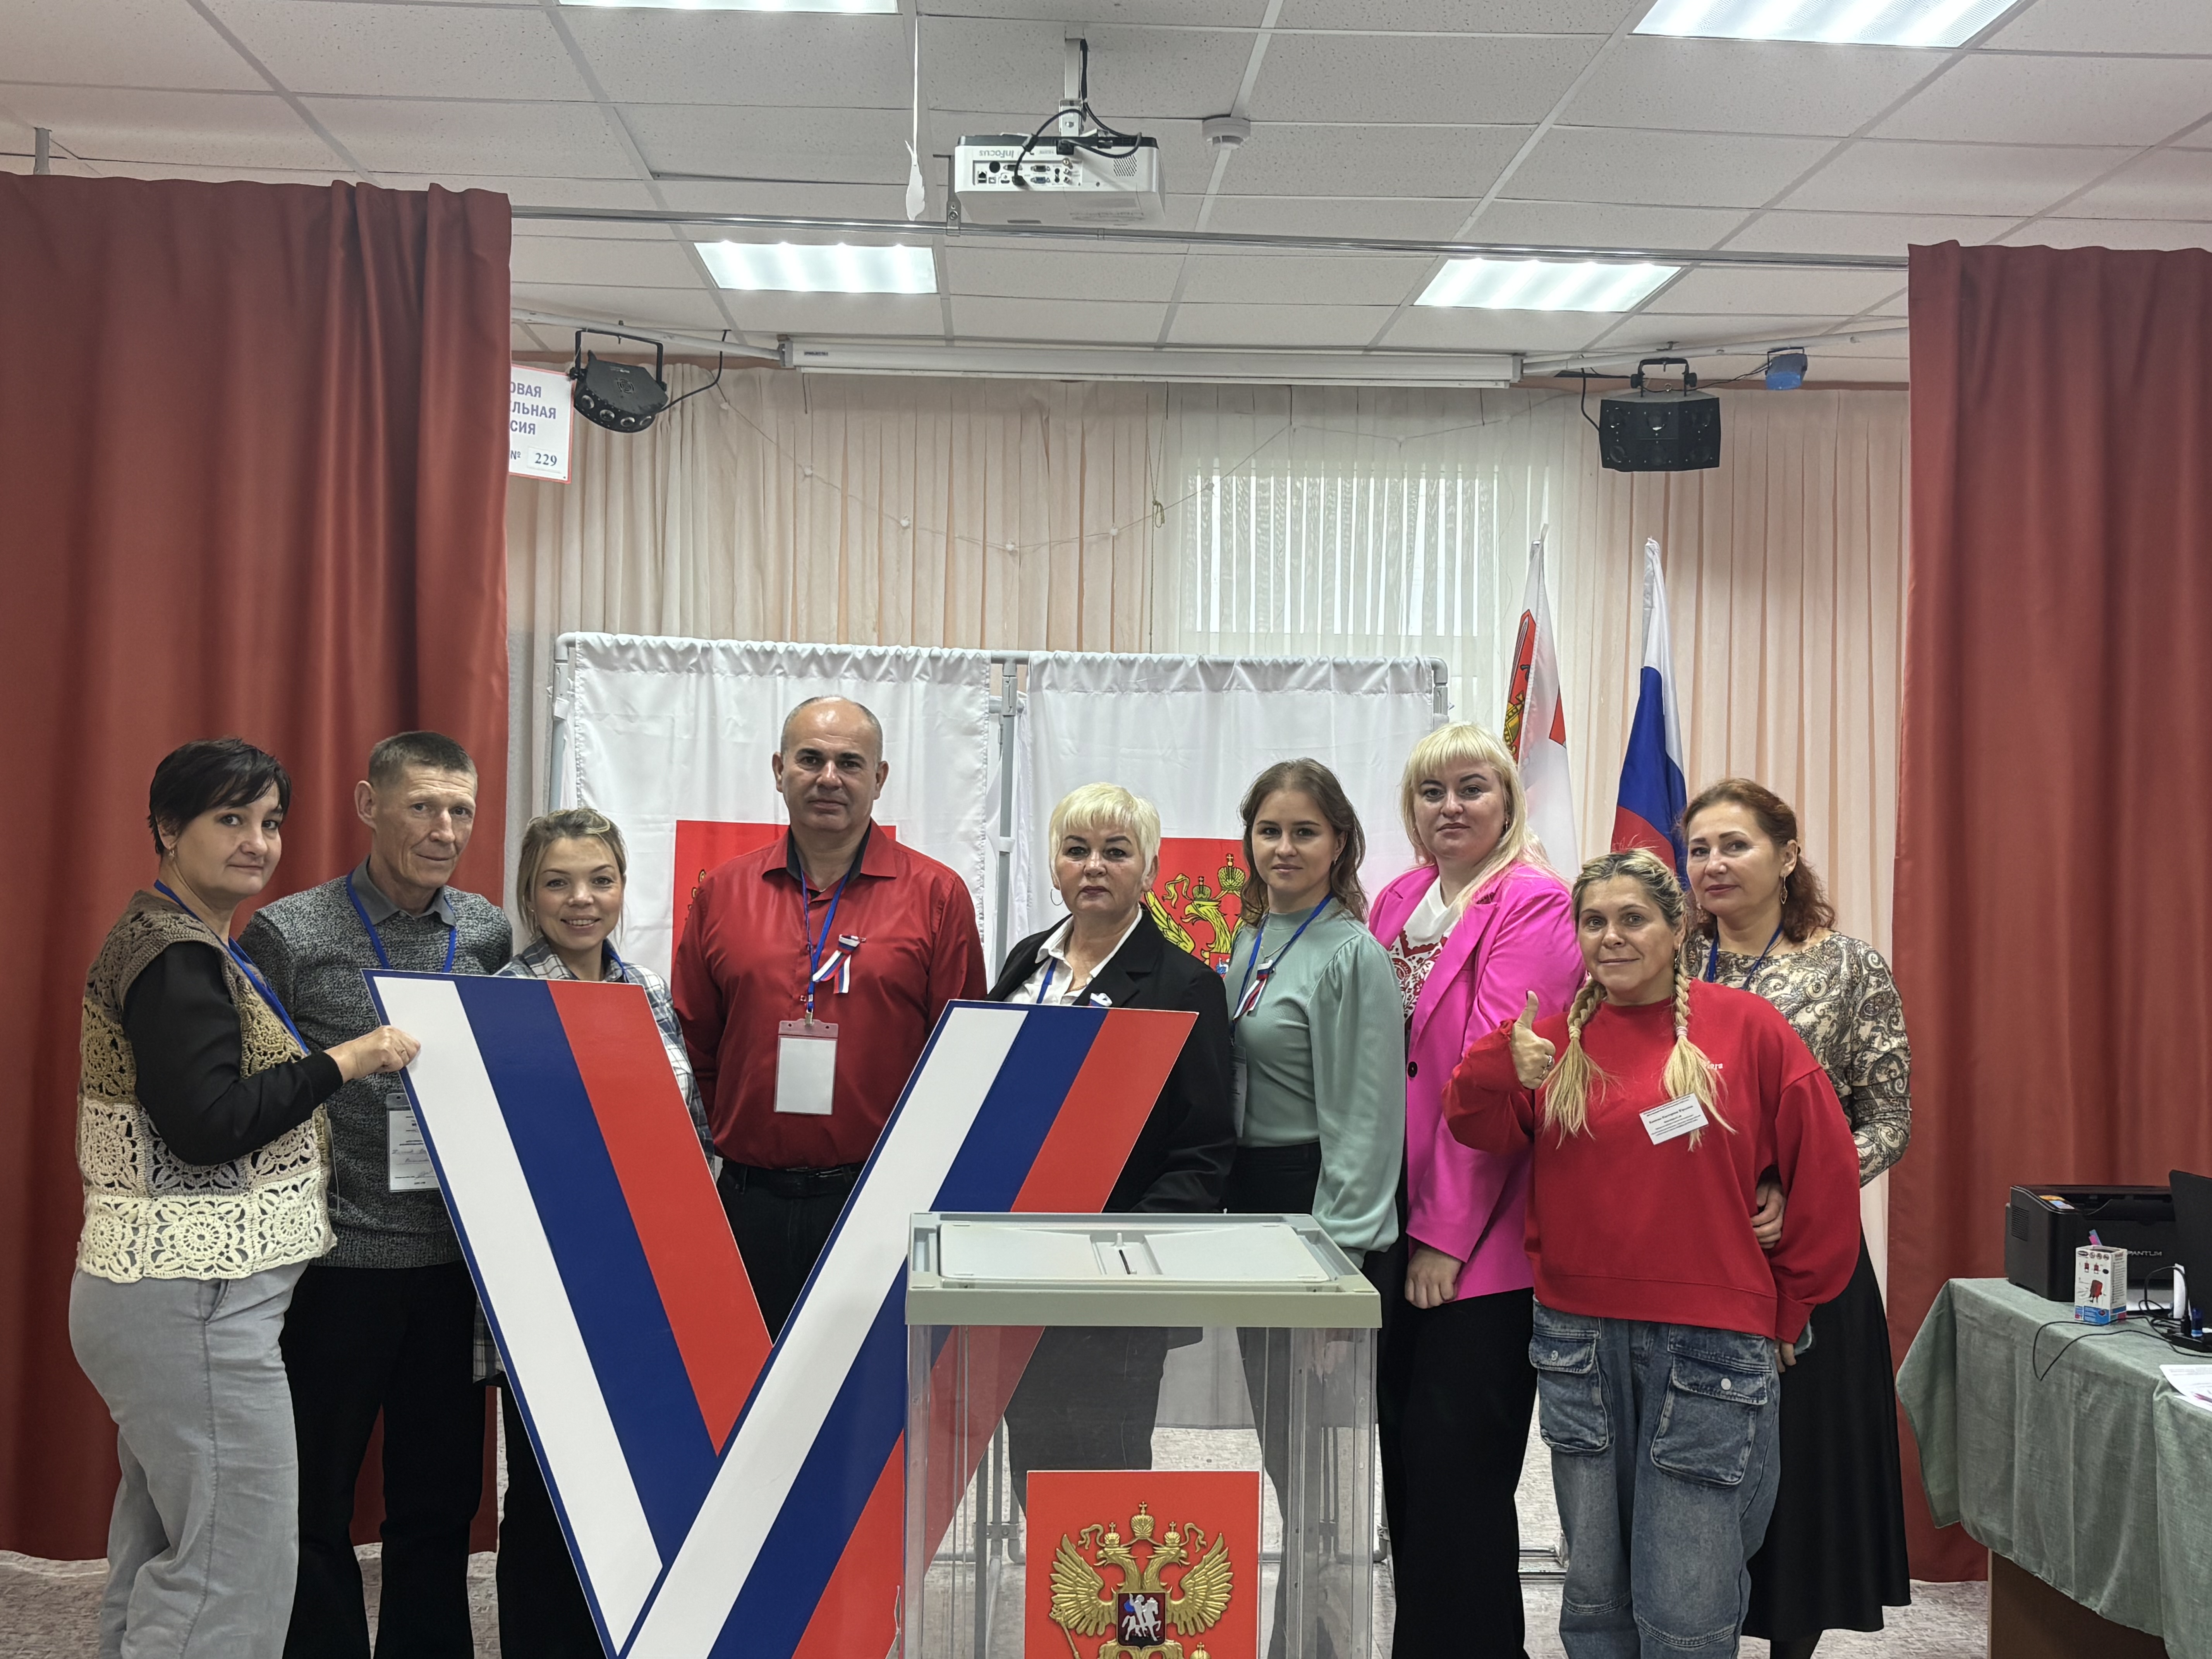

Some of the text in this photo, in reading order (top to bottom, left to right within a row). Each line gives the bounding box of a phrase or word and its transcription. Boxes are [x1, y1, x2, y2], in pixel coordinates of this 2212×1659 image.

[979, 150, 1014, 158] InFocus
[510, 400, 556, 419] ЛЬНАЯ
[510, 420, 536, 435] СИЯ
[534, 452, 557, 466] 229
